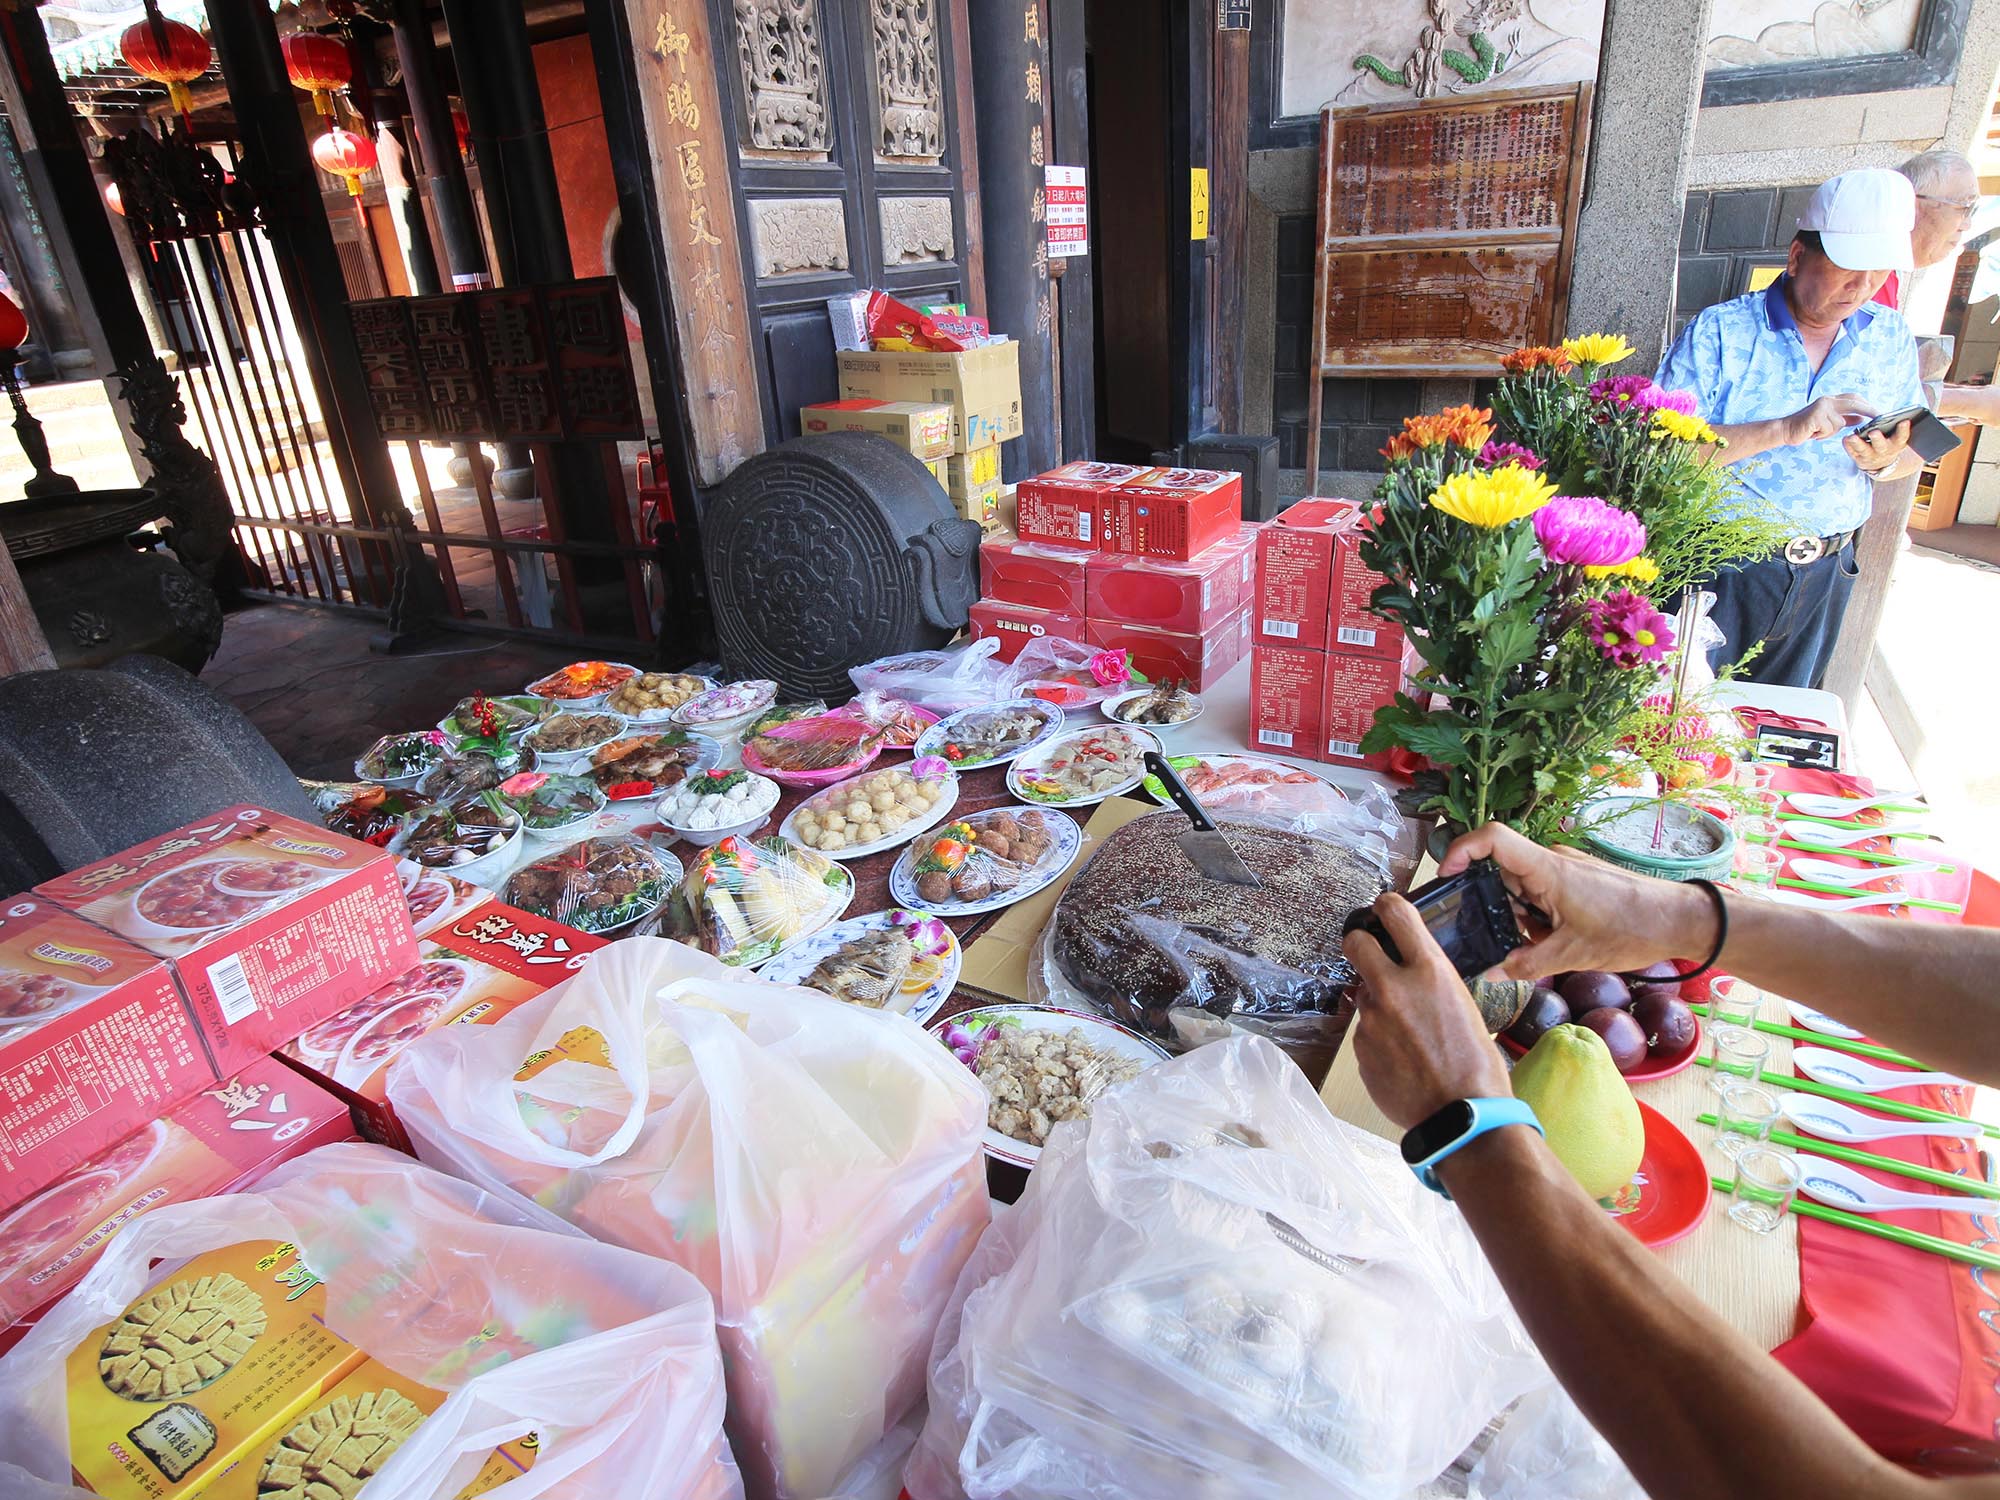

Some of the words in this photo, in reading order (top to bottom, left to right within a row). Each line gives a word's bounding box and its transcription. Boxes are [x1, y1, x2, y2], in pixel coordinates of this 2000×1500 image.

[1196, 181, 1206, 225] 入口
[479, 301, 549, 433] 肅靜
[66, 822, 238, 897] 八寶粥
[452, 914, 571, 965] 八寶粥
